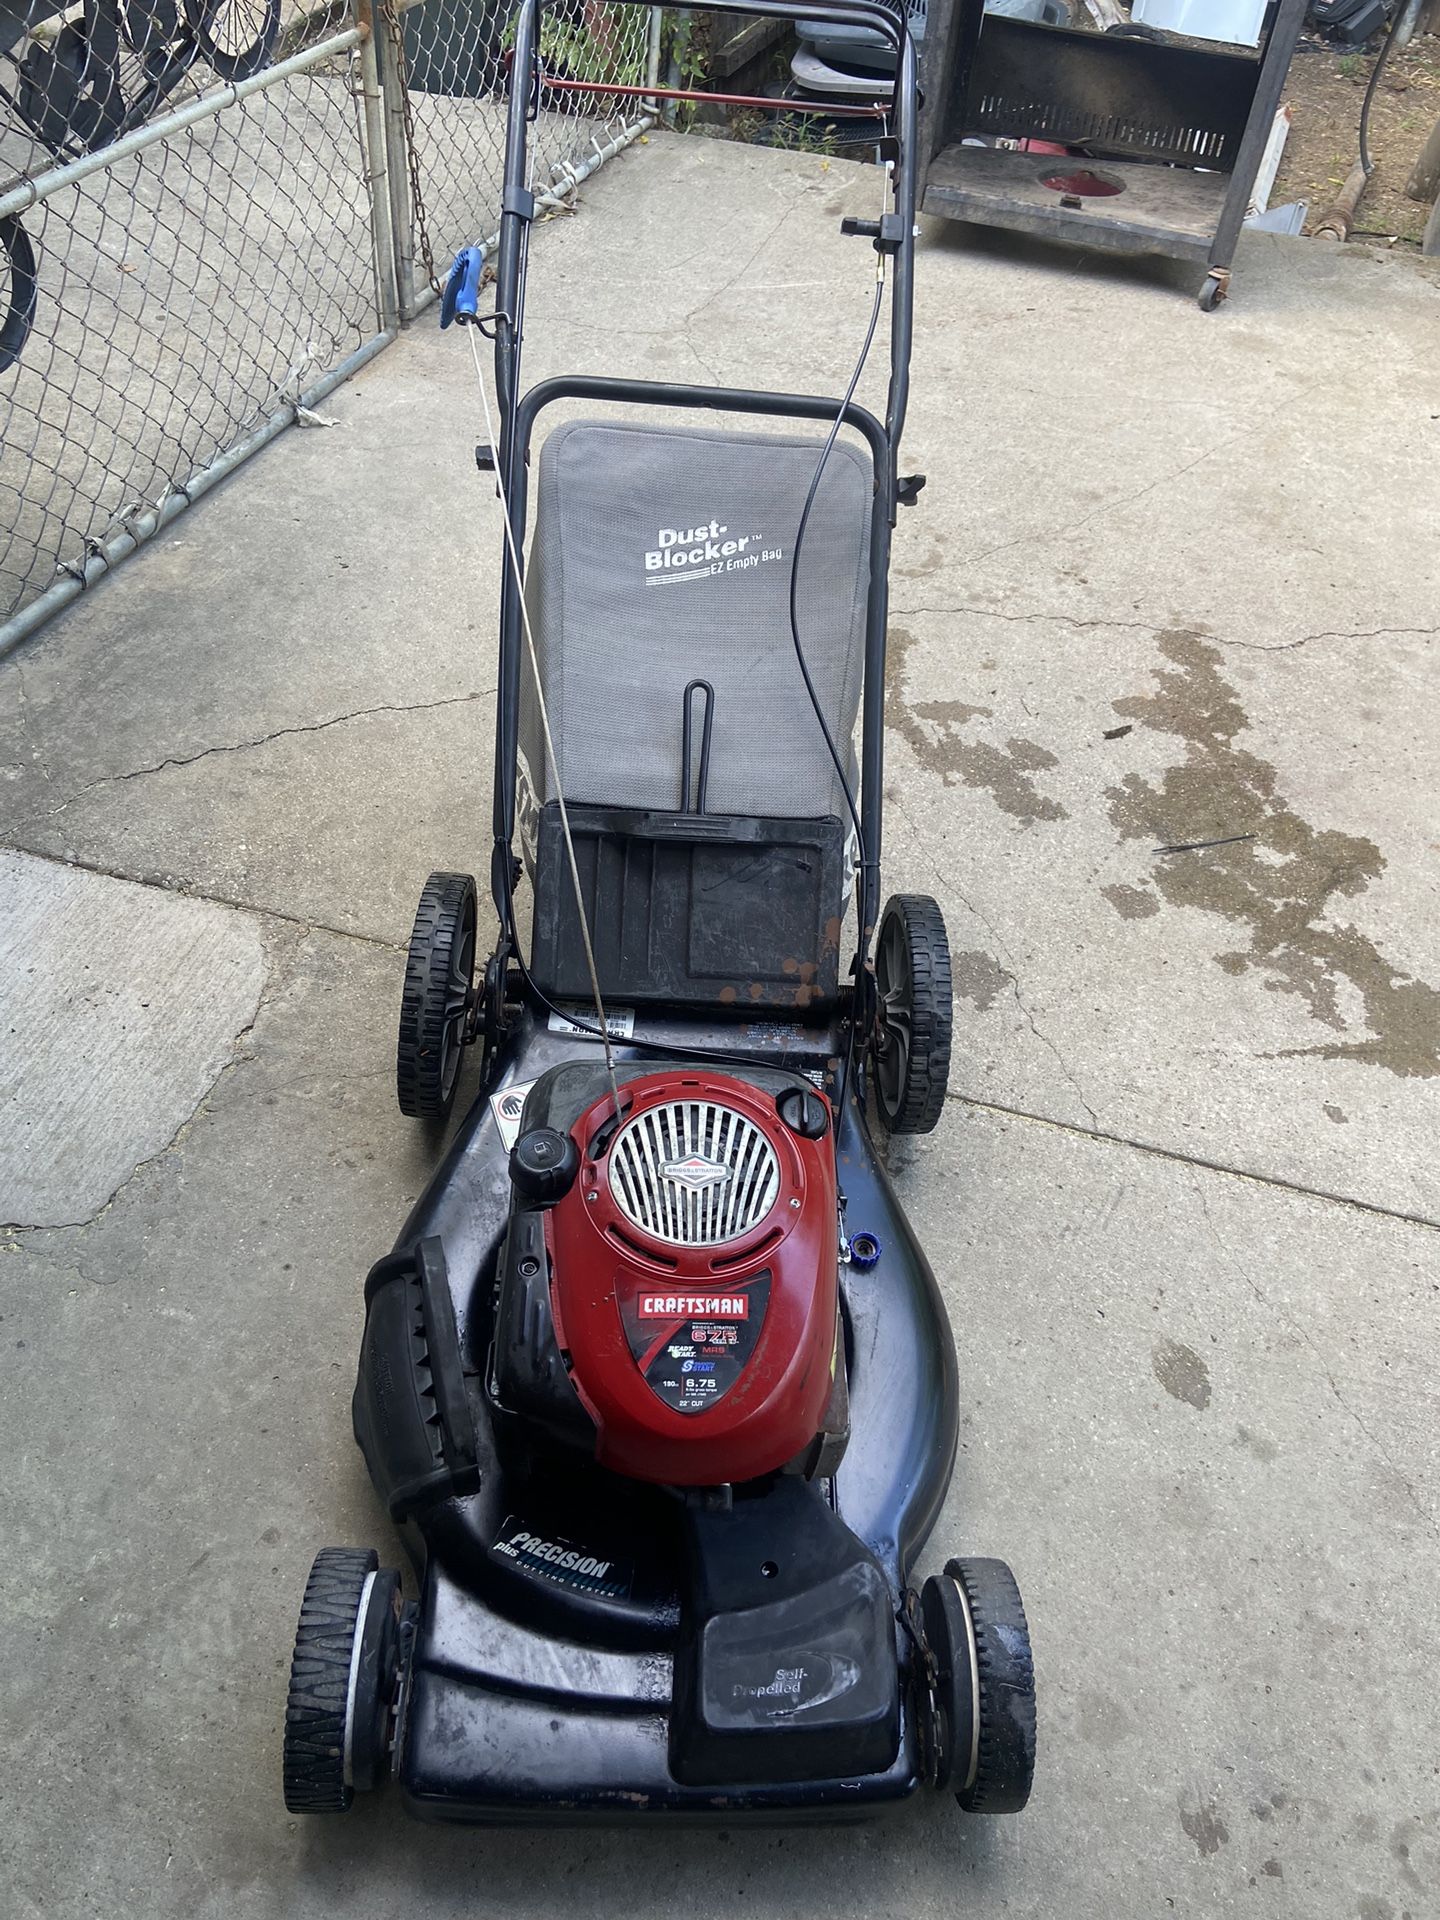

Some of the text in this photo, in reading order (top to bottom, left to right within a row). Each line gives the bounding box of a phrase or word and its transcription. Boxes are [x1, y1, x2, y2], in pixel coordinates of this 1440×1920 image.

[658, 519, 728, 548] Dust-
[645, 536, 749, 570] Blocker
[710, 548, 782, 575] EZ Empty Bag
[643, 1297, 744, 1314] CRAFTSMAN
[691, 1329, 737, 1343] 675
[667, 1345, 695, 1353] READY
[686, 1378, 716, 1388] 6.75
[493, 1541, 520, 1557] plus
[509, 1532, 611, 1578] PRECISION
[515, 1560, 616, 1597] CUTTING SYSTEM
[775, 1667, 809, 1681] Self-
[732, 1682, 801, 1698] Propelled
